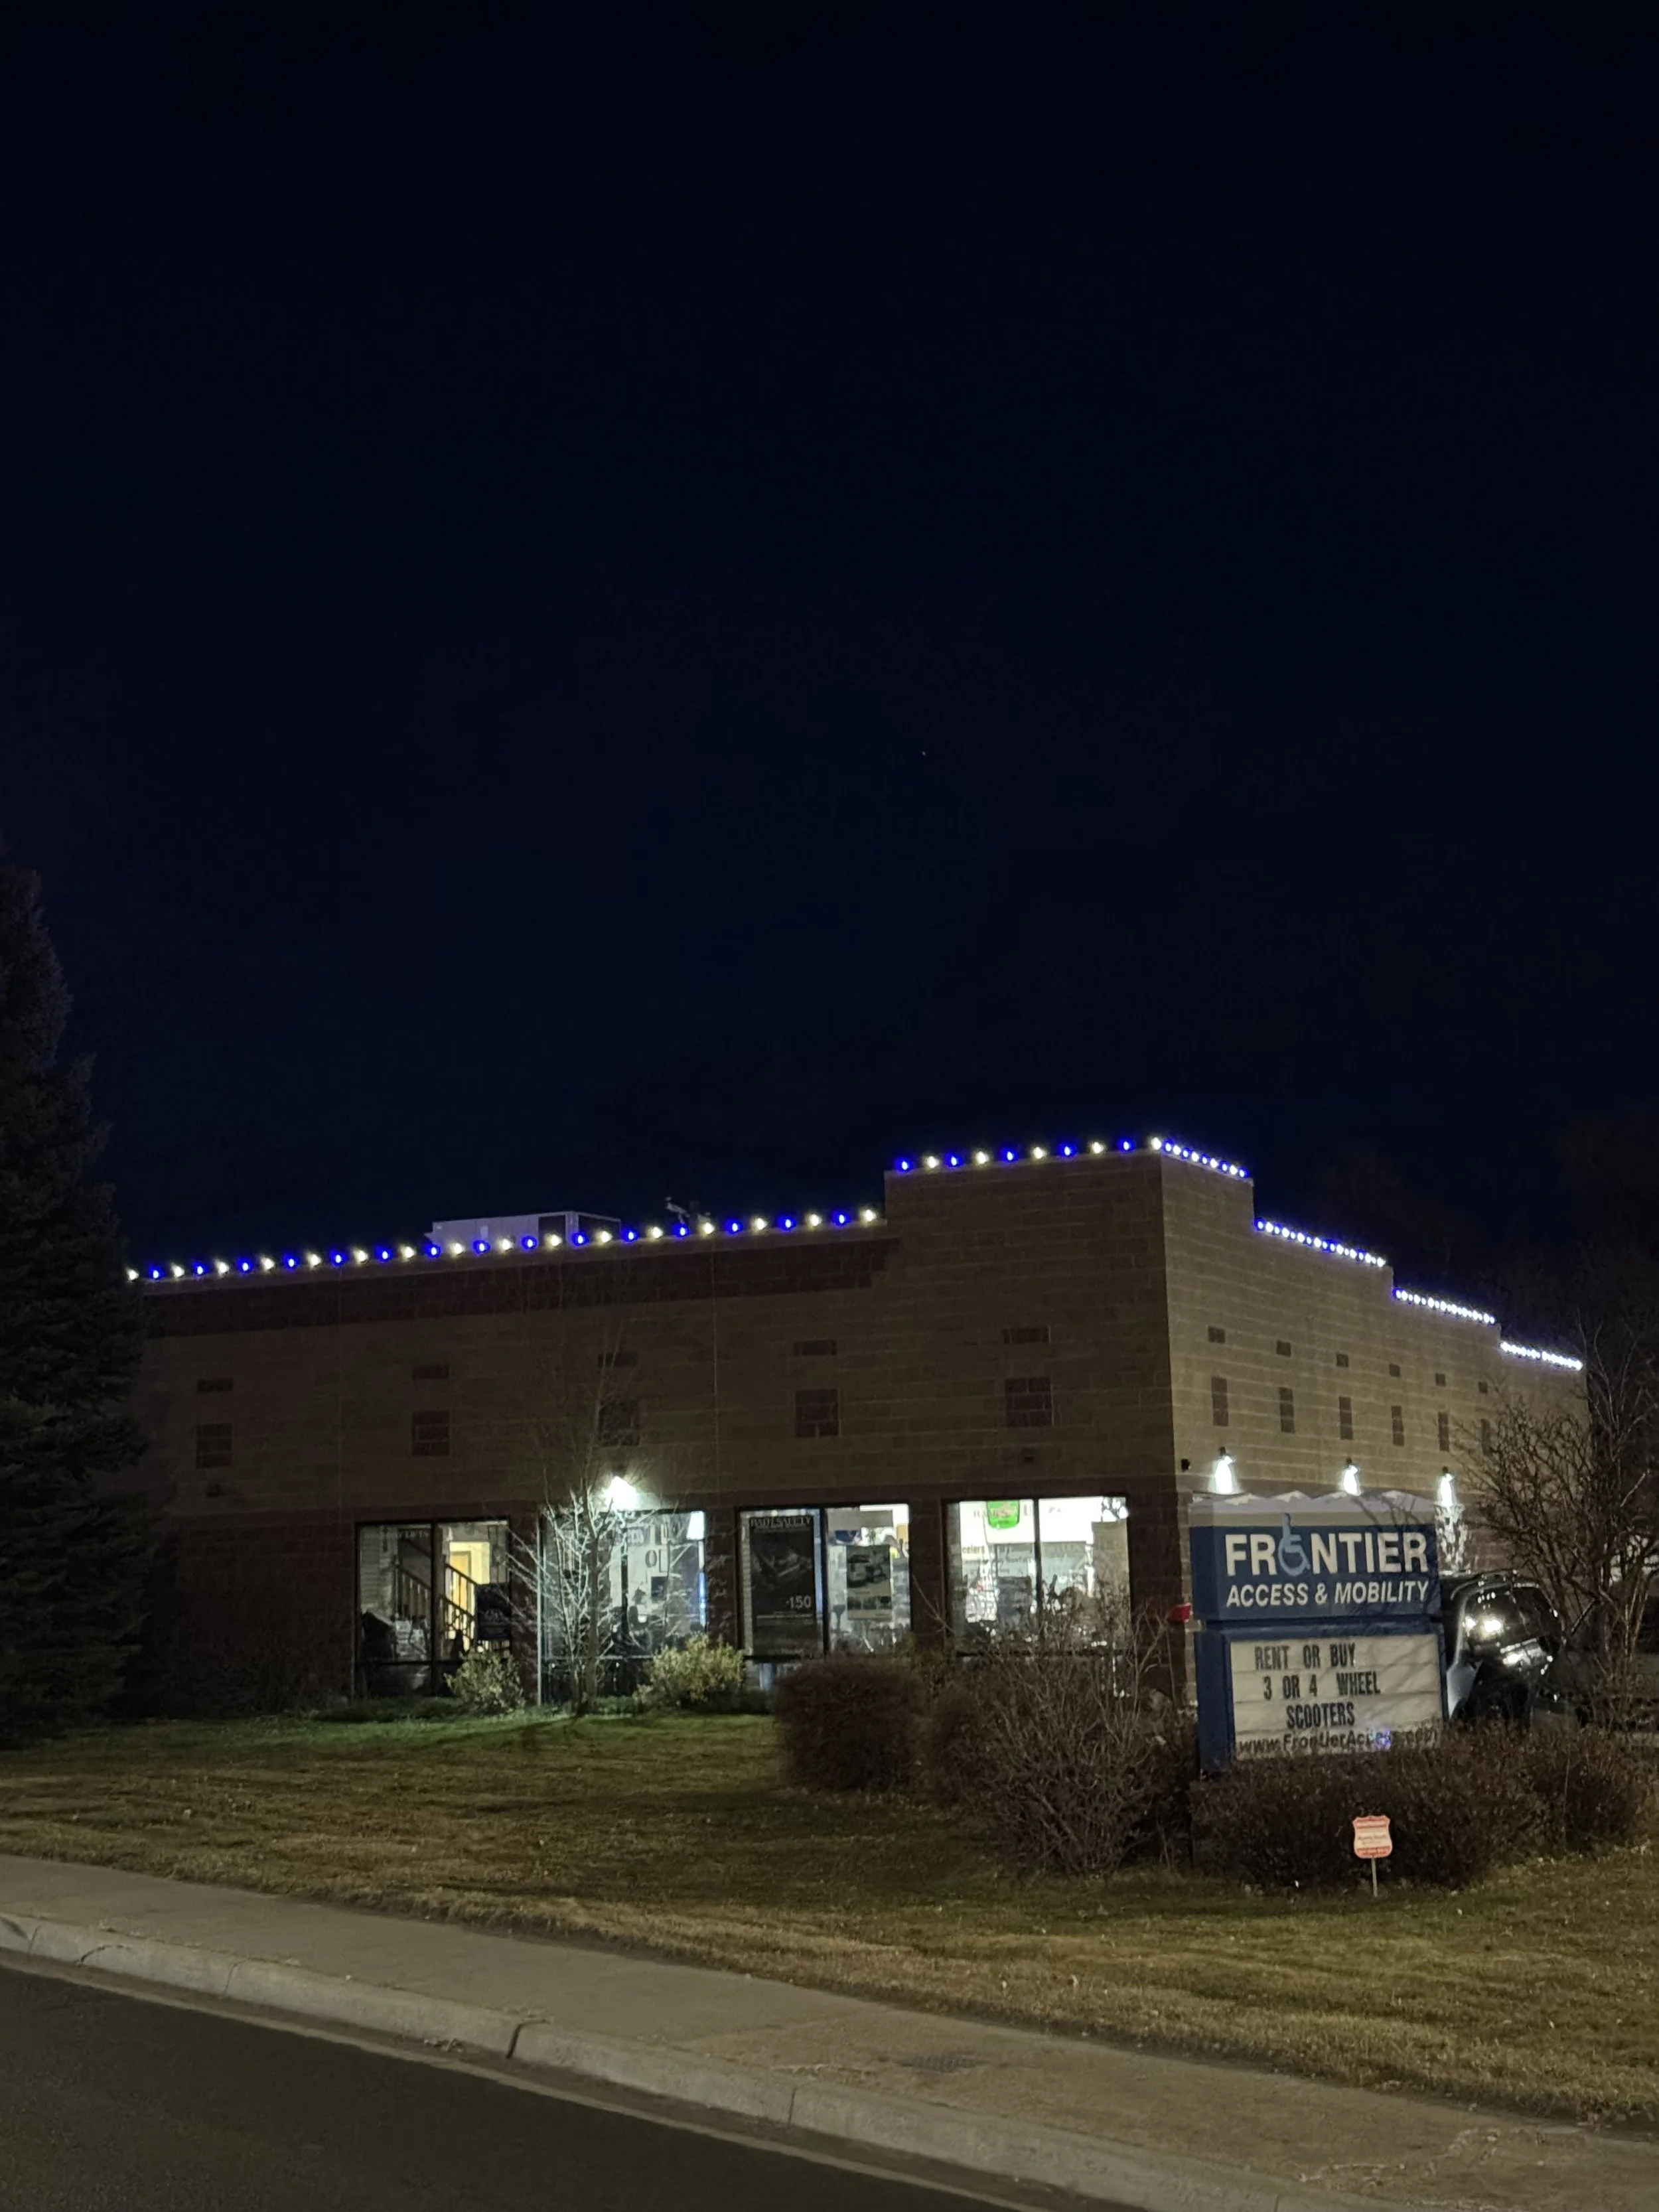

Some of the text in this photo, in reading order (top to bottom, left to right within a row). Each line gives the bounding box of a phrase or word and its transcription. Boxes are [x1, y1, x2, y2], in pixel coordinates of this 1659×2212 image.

[1226, 1580, 1428, 1607] ACCESS & MOBILITY
[1255, 1643, 1355, 1670] RENT OR BUY
[1263, 1670, 1381, 1700] 3 OR 4 WHEEL
[1286, 1701, 1355, 1729] SCOOTERS
[1239, 1728, 1439, 1754] www.FrontierAccom
